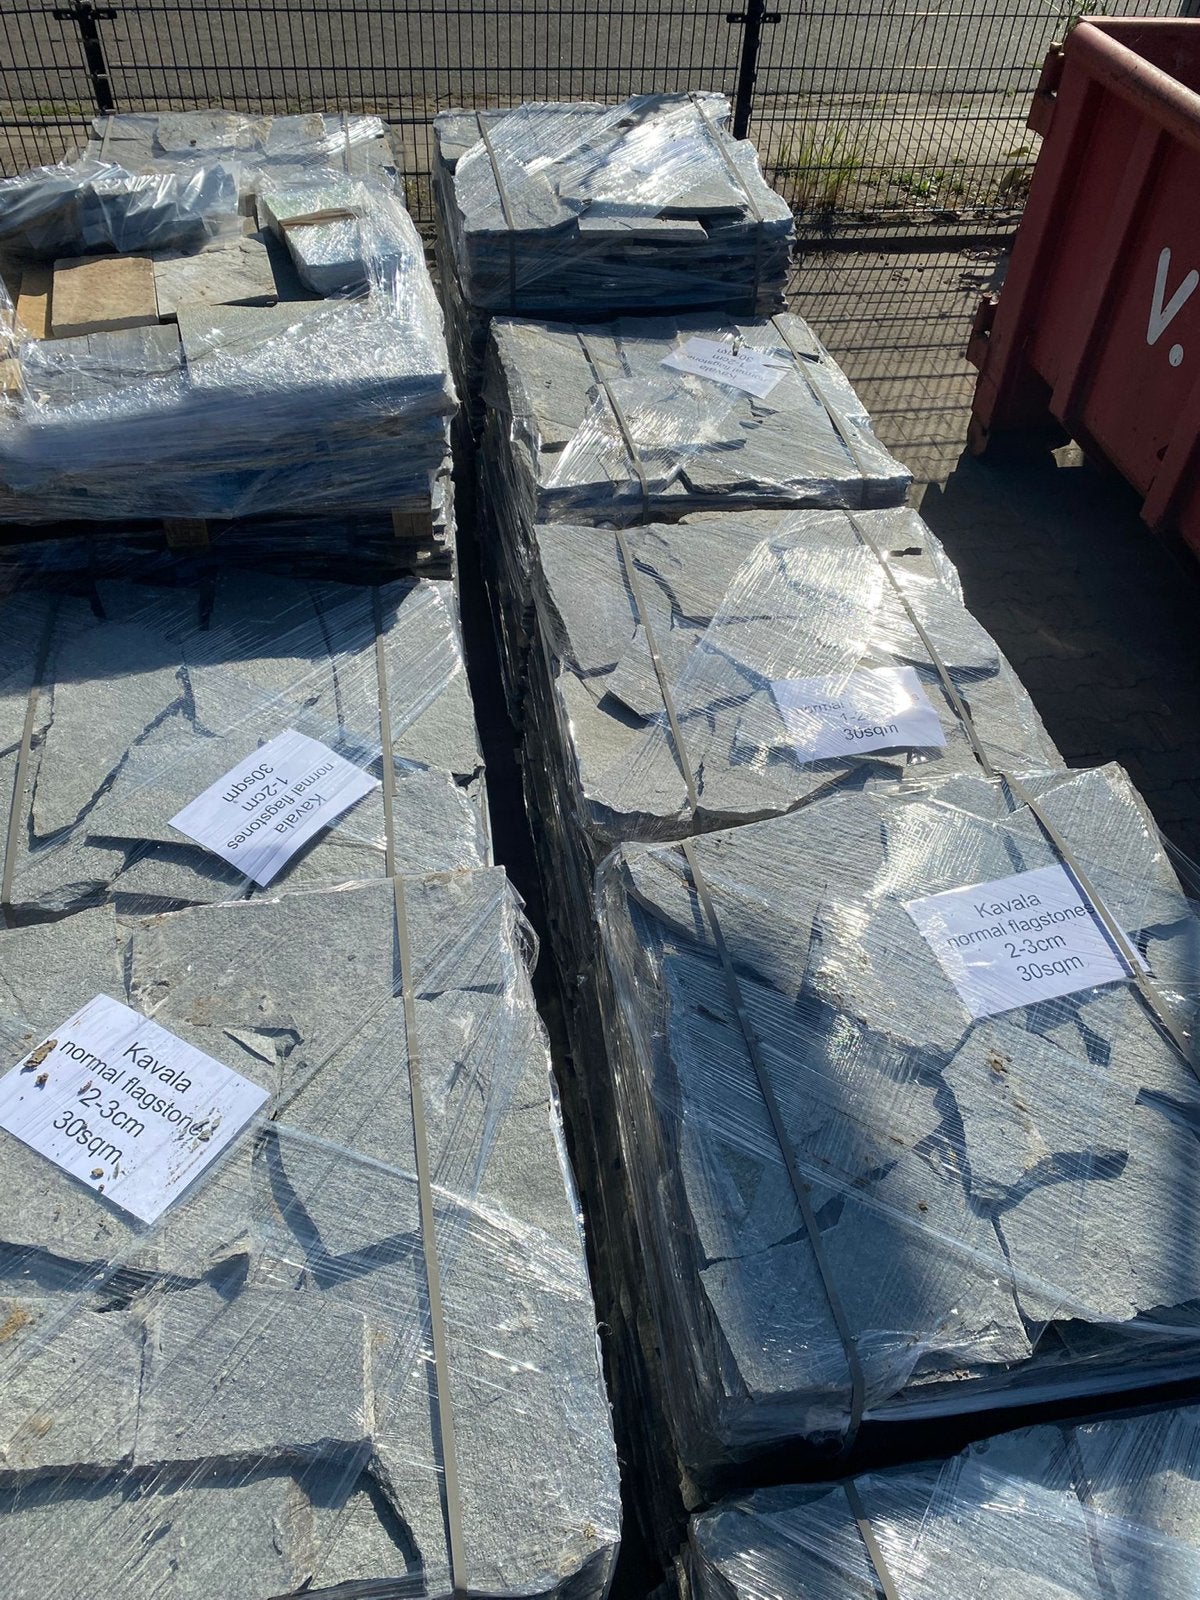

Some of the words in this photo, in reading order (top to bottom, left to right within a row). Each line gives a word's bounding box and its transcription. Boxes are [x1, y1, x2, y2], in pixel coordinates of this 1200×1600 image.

[843, 723, 899, 741] 30sqm
[222, 763, 274, 804] 30sqm
[241, 776, 289, 812] 1-2cm
[291, 762, 334, 798] normal
[227, 797, 294, 850] flagstones
[274, 792, 327, 834] Kavala
[947, 922, 1007, 949] normal
[1008, 902, 1096, 934] flagstones
[973, 893, 1042, 918] Kavala
[1004, 934, 1067, 959] 2-3cm
[1016, 955, 1084, 982] 30sqm
[122, 1041, 193, 1094] Kavala
[60, 1040, 124, 1084] normal
[122, 1078, 210, 1142] flagstone
[79, 1088, 145, 1138] 2-3cm
[53, 1110, 123, 1166] 30sqm
